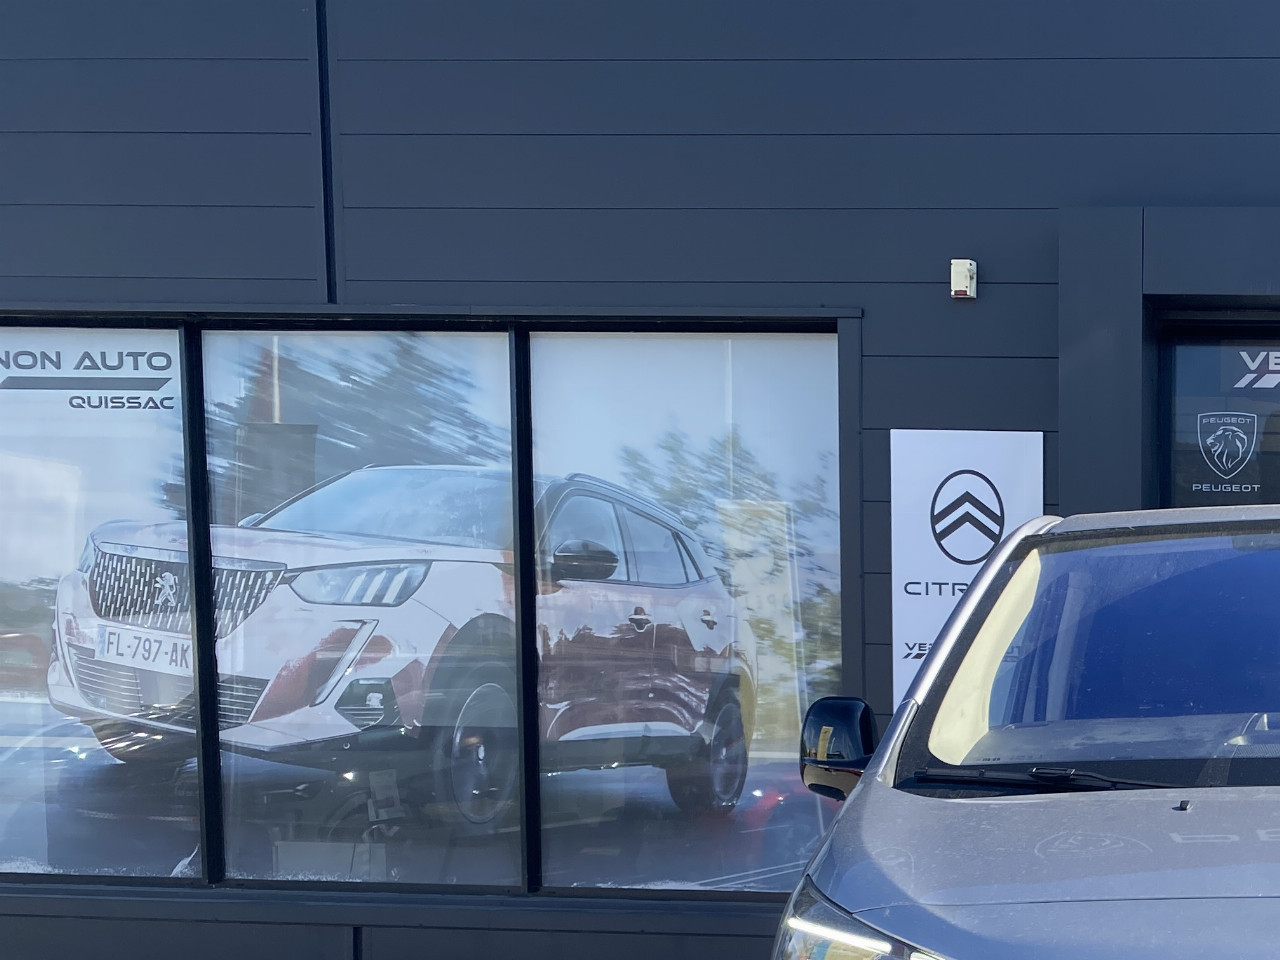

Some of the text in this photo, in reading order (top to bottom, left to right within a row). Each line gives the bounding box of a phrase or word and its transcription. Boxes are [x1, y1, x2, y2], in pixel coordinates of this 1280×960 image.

[73, 351, 172, 371] AUTO
[68, 395, 175, 410] QUISSAC
[1202, 417, 1252, 425] PEUGEOT
[1192, 484, 1261, 493] PEUGEOT
[106, 631, 191, 670] FL-797-AK
